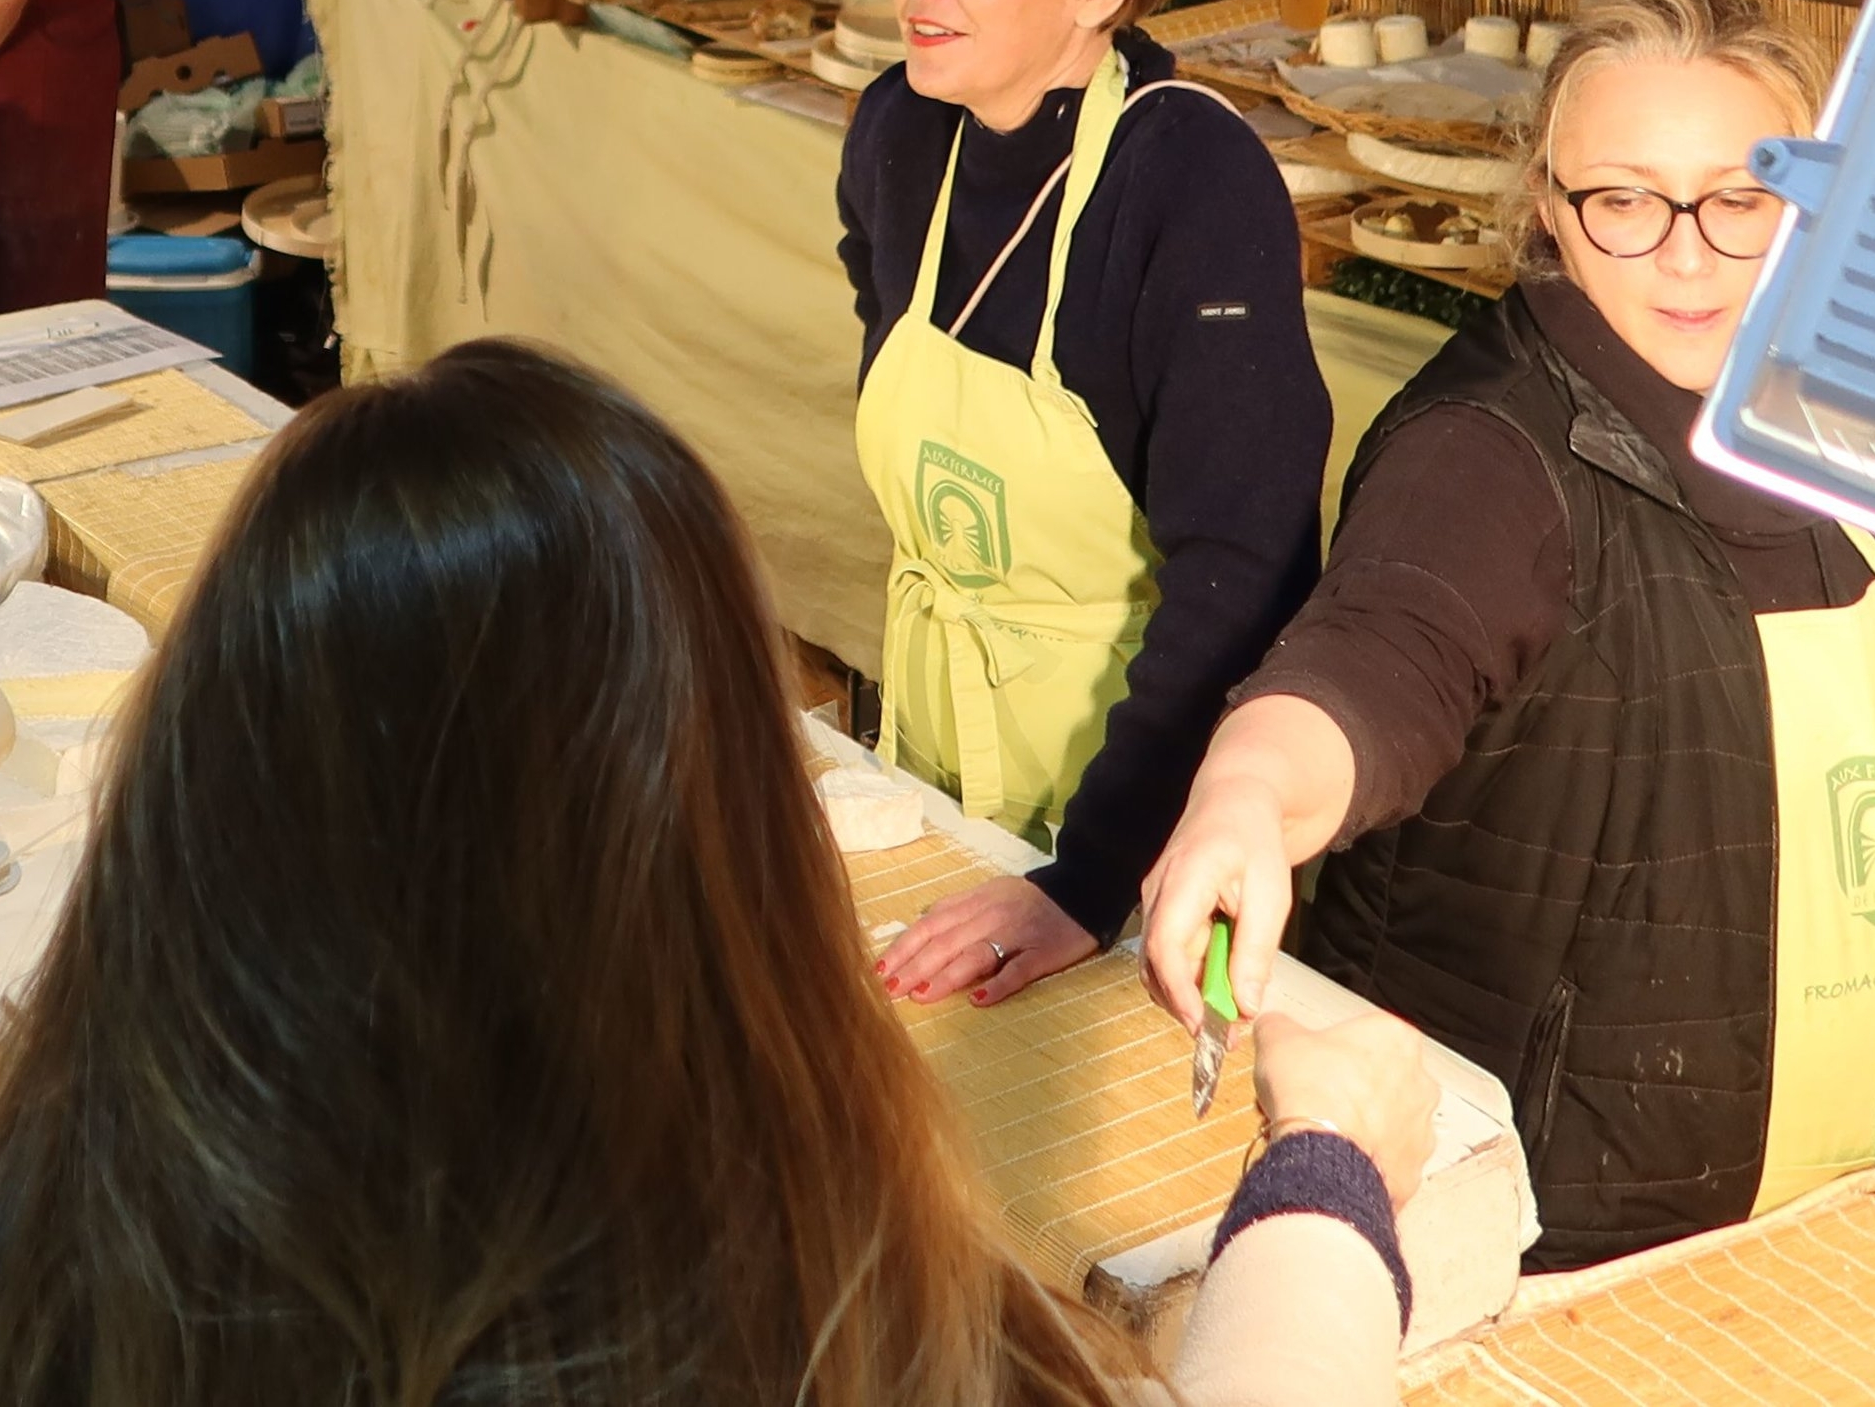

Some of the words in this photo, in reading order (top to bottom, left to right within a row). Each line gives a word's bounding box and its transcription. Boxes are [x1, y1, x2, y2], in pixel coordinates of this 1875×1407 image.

[922, 447, 948, 467] AUX
[948, 458, 1002, 494] FERMES
[1831, 765, 1860, 792] AUX
